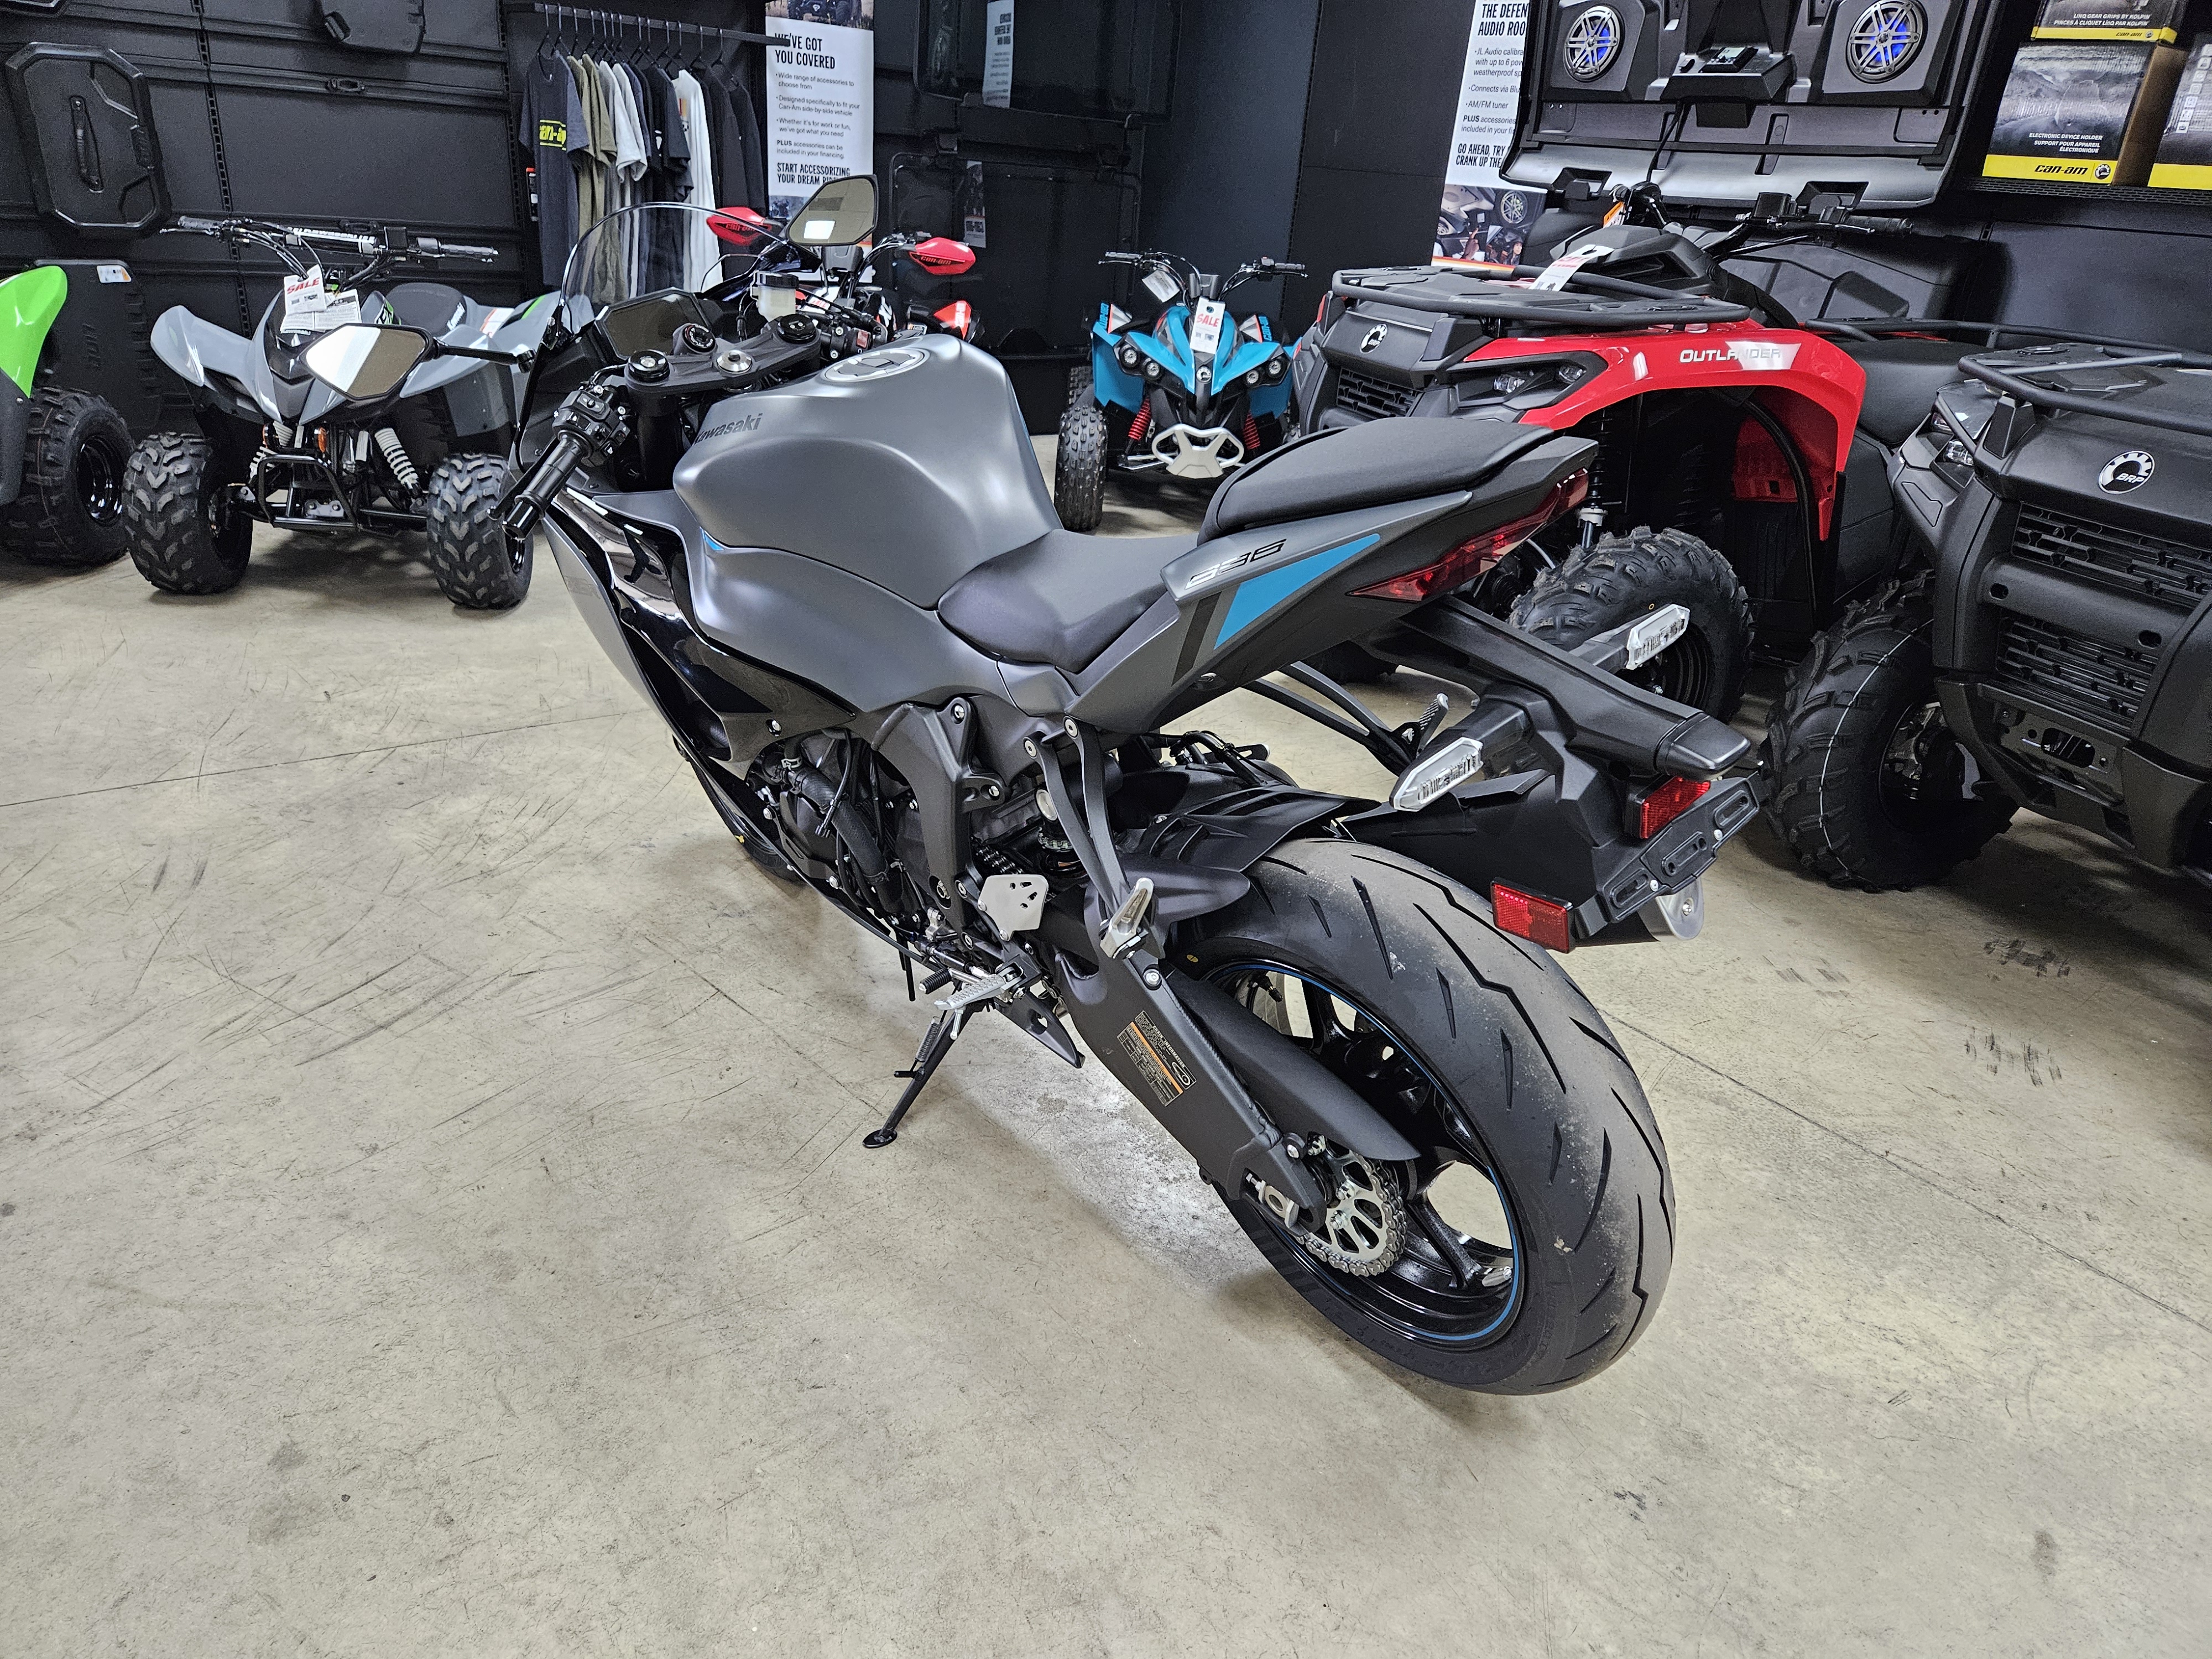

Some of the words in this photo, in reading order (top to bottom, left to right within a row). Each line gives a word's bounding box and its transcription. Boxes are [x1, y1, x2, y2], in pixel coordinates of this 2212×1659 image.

[1482, 3, 1499, 18] THE
[1500, 3, 1529, 18] DEFEN
[1478, 21, 1505, 36] AUDIO
[1507, 21, 1526, 36] ROO
[806, 37, 822, 51] GOT
[775, 49, 793, 64] YOU
[796, 52, 836, 69] COVERED
[1474, 69, 1514, 77] weatherproof
[817, 77, 848, 86] accessories
[1471, 84, 1499, 92] Connects
[779, 95, 805, 103] Designed
[806, 97, 835, 107] specifically
[1458, 143, 1467, 154] GO
[1468, 144, 1490, 157] AHEAD,
[1493, 145, 1506, 156] TRY
[1456, 155, 1478, 166] CRANK
[1479, 157, 1488, 166] UP
[1489, 157, 1502, 168] THE
[777, 162, 797, 173] START
[800, 164, 850, 176] ACCESSORIZING
[2034, 165, 2088, 175] can-am
[777, 173, 795, 184] YOUR
[797, 175, 820, 185] DREAM
[920, 256, 951, 265] can-am
[287, 278, 320, 294] SALE
[1196, 313, 1219, 327] SALE
[1679, 348, 1781, 363] OUTLANDER
[2116, 473, 2145, 483] BRP
[1152, 1025, 1164, 1039] CHAIN
[1164, 1040, 1186, 1068] INFORMATION
